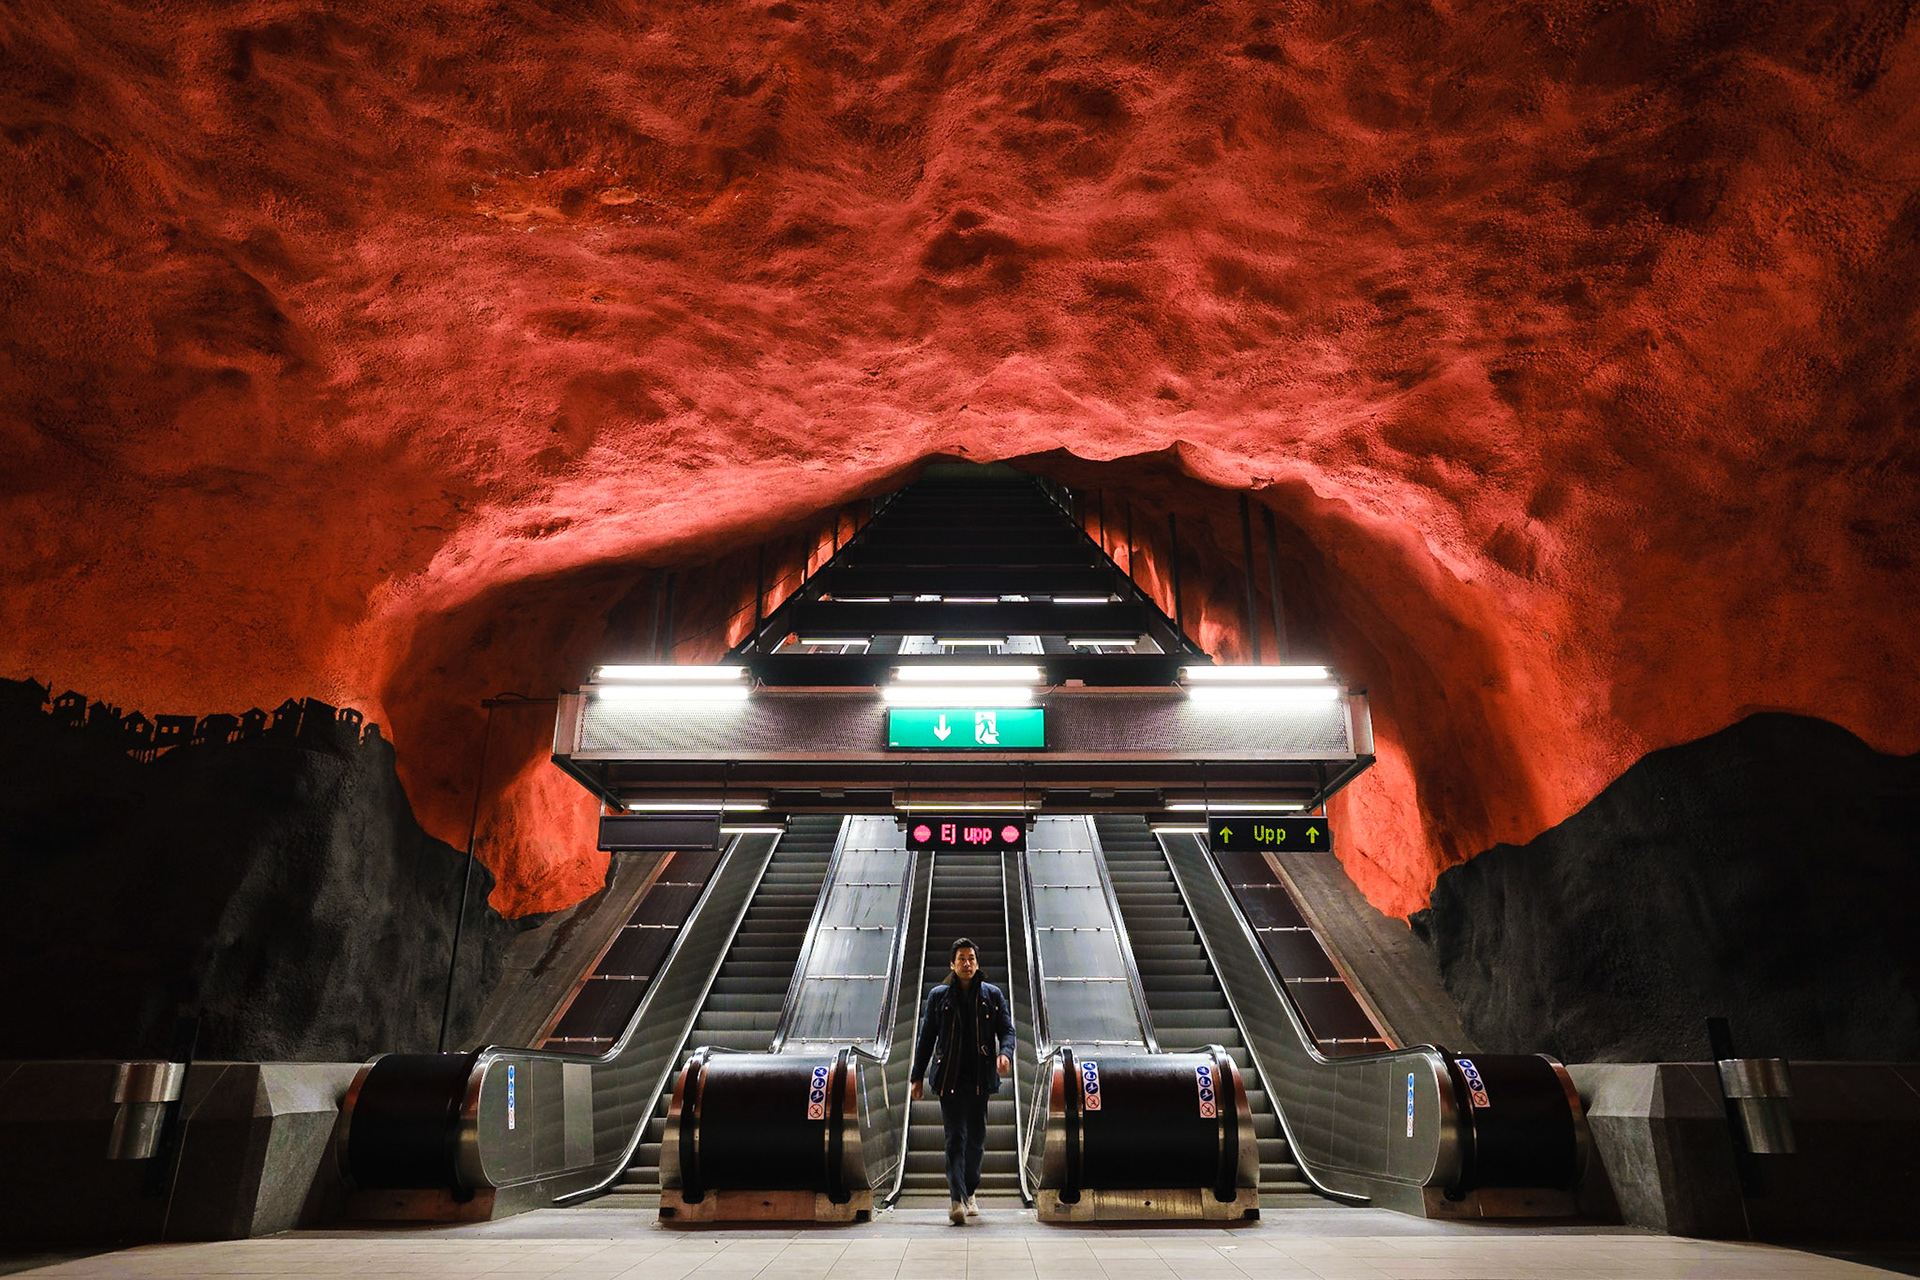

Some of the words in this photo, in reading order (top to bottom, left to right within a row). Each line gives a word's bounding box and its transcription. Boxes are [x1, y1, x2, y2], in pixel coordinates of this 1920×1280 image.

[941, 823, 957, 845] Ej
[964, 827, 993, 845] upp
[1254, 825, 1286, 845] Upp
